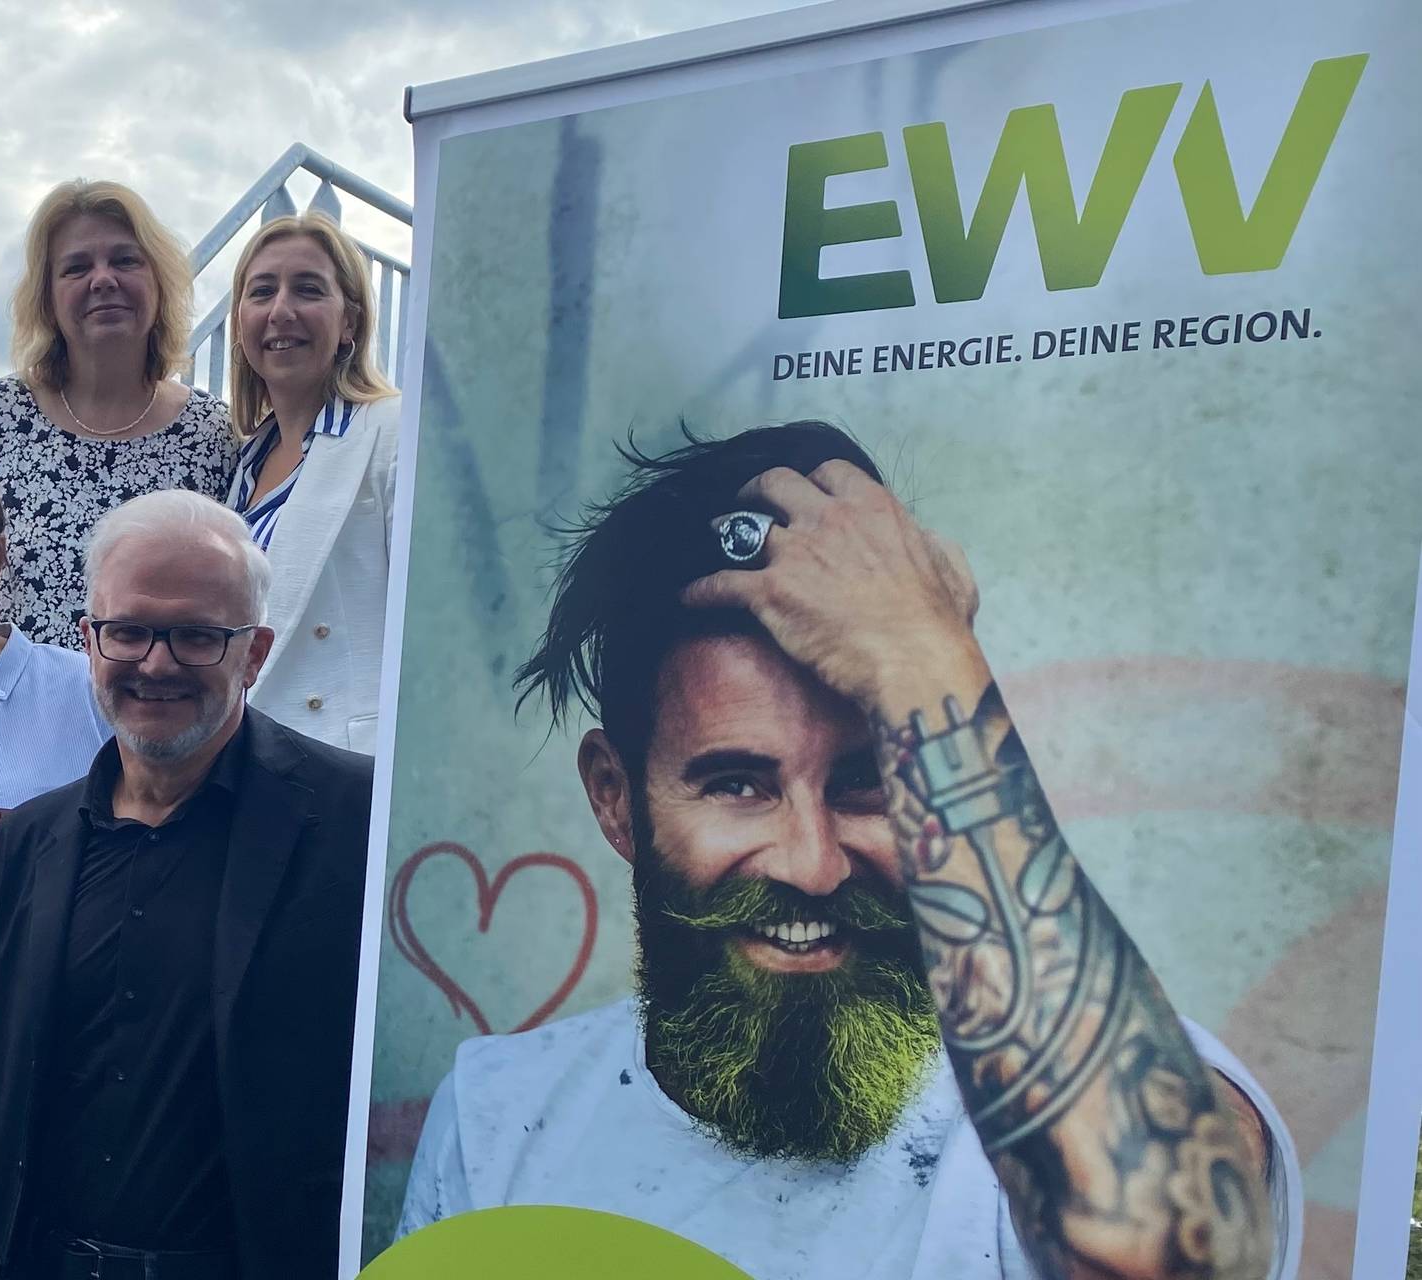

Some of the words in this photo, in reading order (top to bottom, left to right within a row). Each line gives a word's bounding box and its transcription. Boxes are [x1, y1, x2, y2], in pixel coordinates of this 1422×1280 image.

[778, 53, 1370, 320] EWV
[772, 347, 863, 381] DEINE
[873, 334, 1022, 373] ENERGIE.
[1031, 321, 1140, 361] DEINE
[1152, 307, 1322, 350] REGION.
